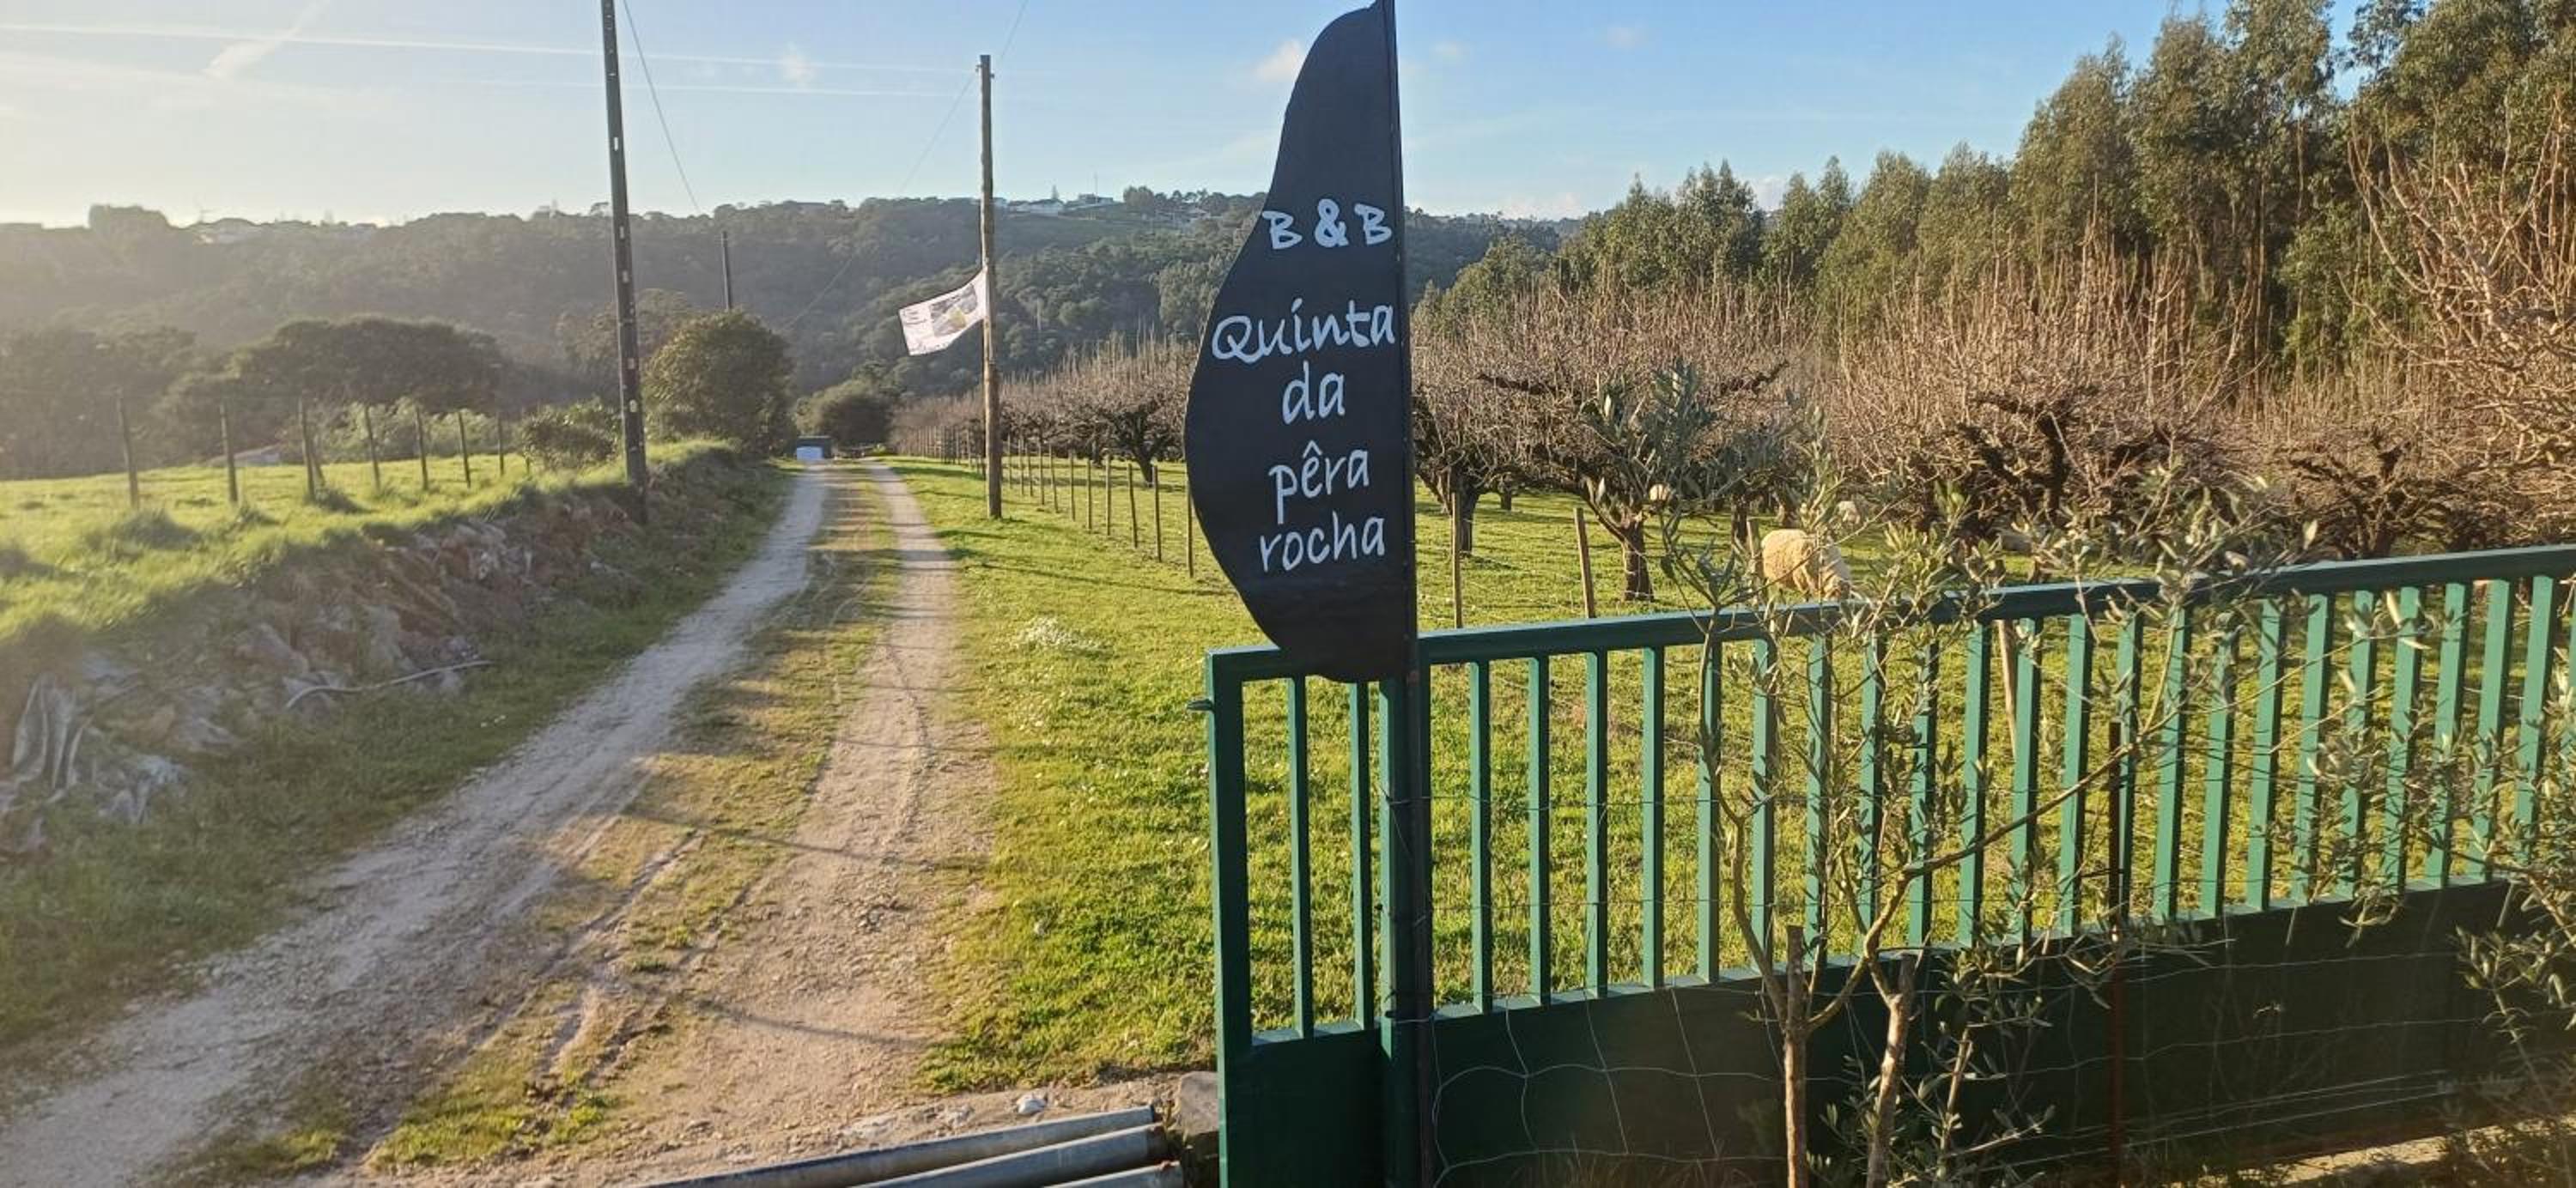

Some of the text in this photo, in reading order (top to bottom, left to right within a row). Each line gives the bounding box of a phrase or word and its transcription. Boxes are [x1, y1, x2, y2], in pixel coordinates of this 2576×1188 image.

[1262, 198, 1392, 250] B & B
[1212, 298, 1395, 363] Quinta
[1282, 361, 1346, 424] da
[1268, 440, 1370, 524] pêra
[1260, 511, 1385, 573] rocha
